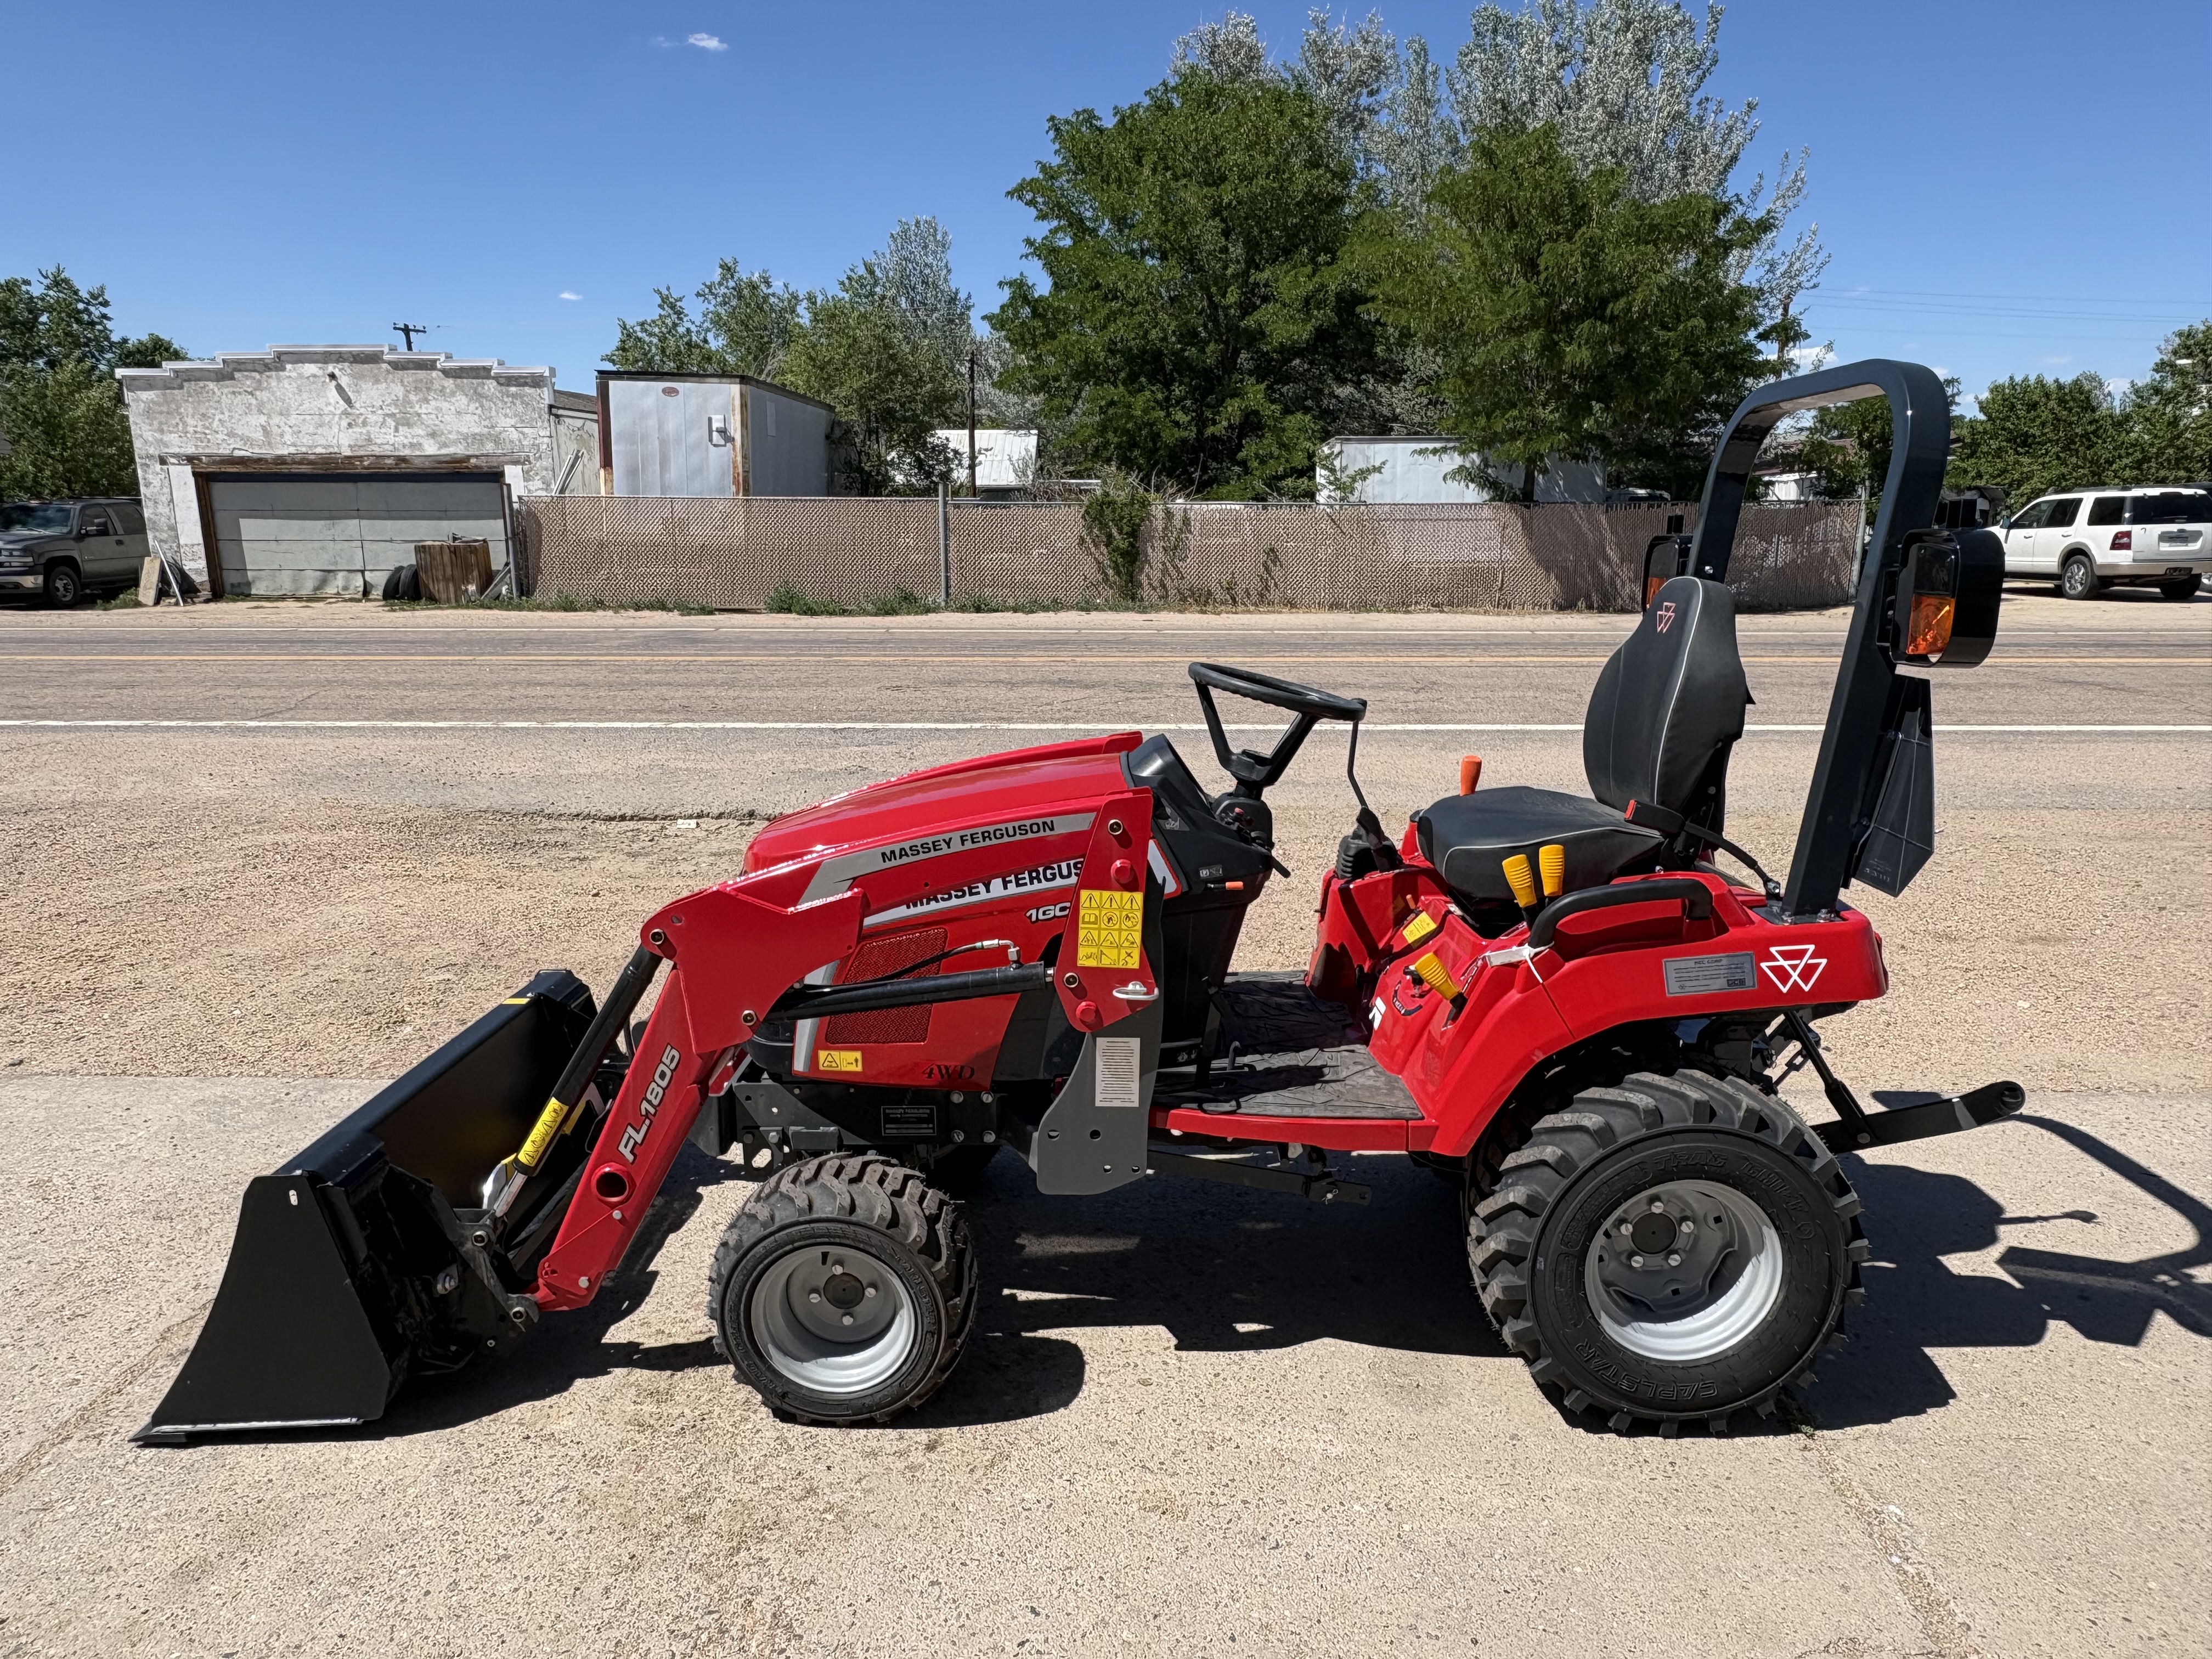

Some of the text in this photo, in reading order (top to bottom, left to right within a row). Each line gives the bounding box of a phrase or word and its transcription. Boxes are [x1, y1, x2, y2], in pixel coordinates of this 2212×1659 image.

[881, 820, 1055, 864] MASSEY FERGUSON
[921, 1063, 975, 1080] 4WD
